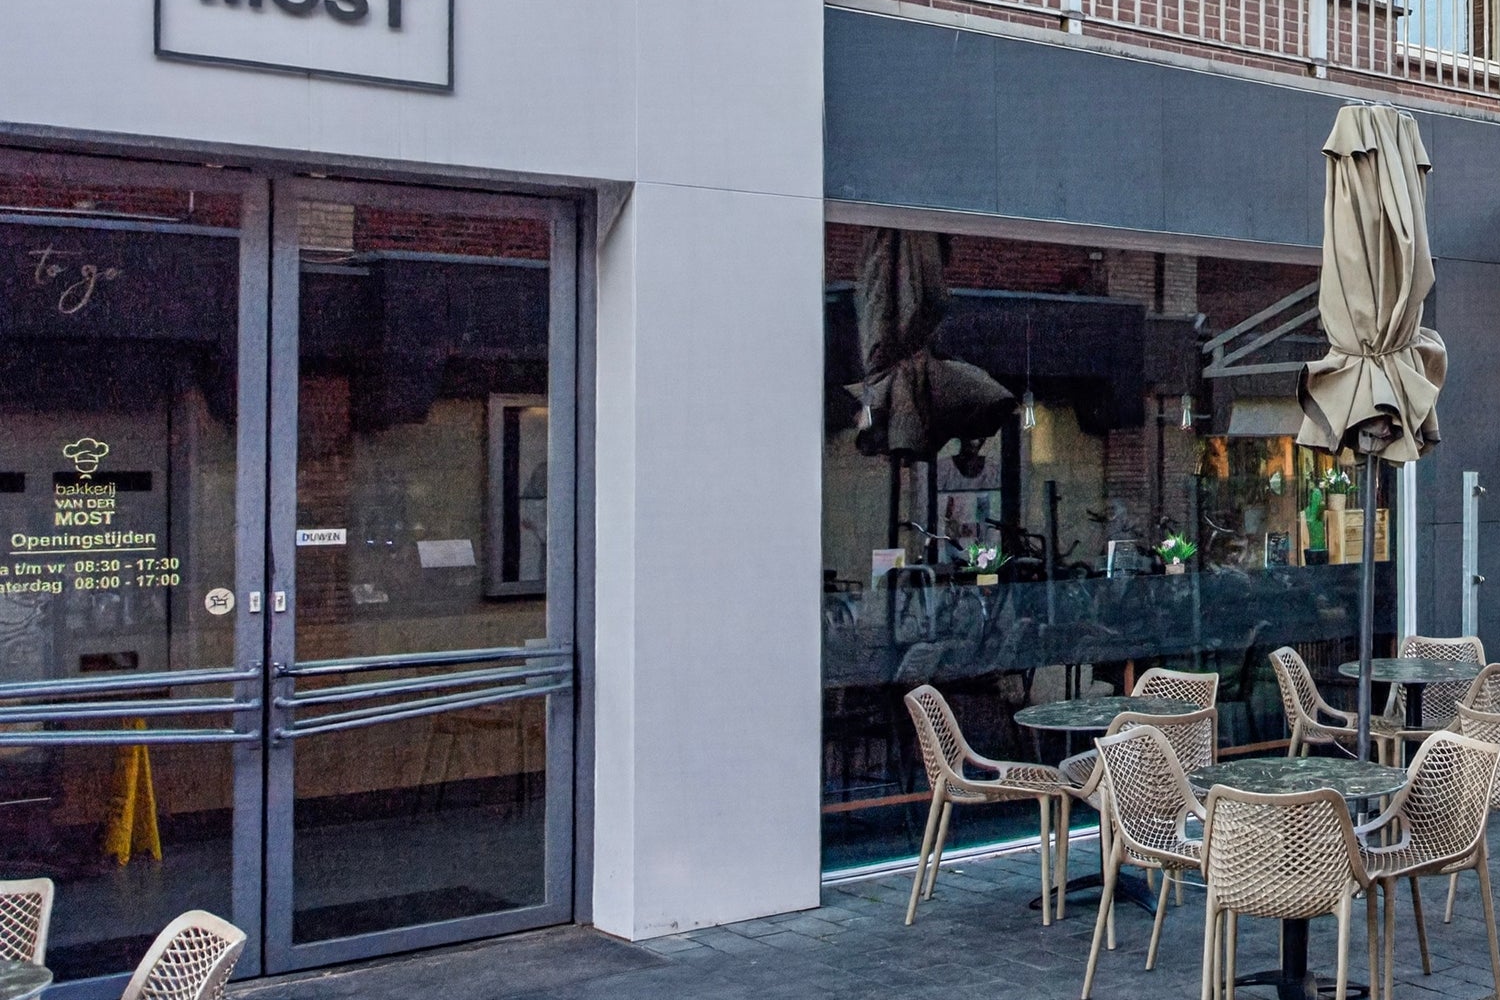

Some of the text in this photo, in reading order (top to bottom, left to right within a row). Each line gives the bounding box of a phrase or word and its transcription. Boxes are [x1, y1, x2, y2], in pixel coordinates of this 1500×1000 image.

[55, 482, 116, 498] bakkerij
[55, 499, 115, 509] VAN DER
[55, 511, 115, 526] MOST
[11, 531, 156, 549] Openingstijden
[15, 562, 42, 576] t/m
[47, 563, 66, 574] vr
[74, 560, 120, 573] 08:30
[136, 558, 180, 571] 17:30
[74, 576, 120, 589] 08:00
[136, 574, 180, 587] 17:00
